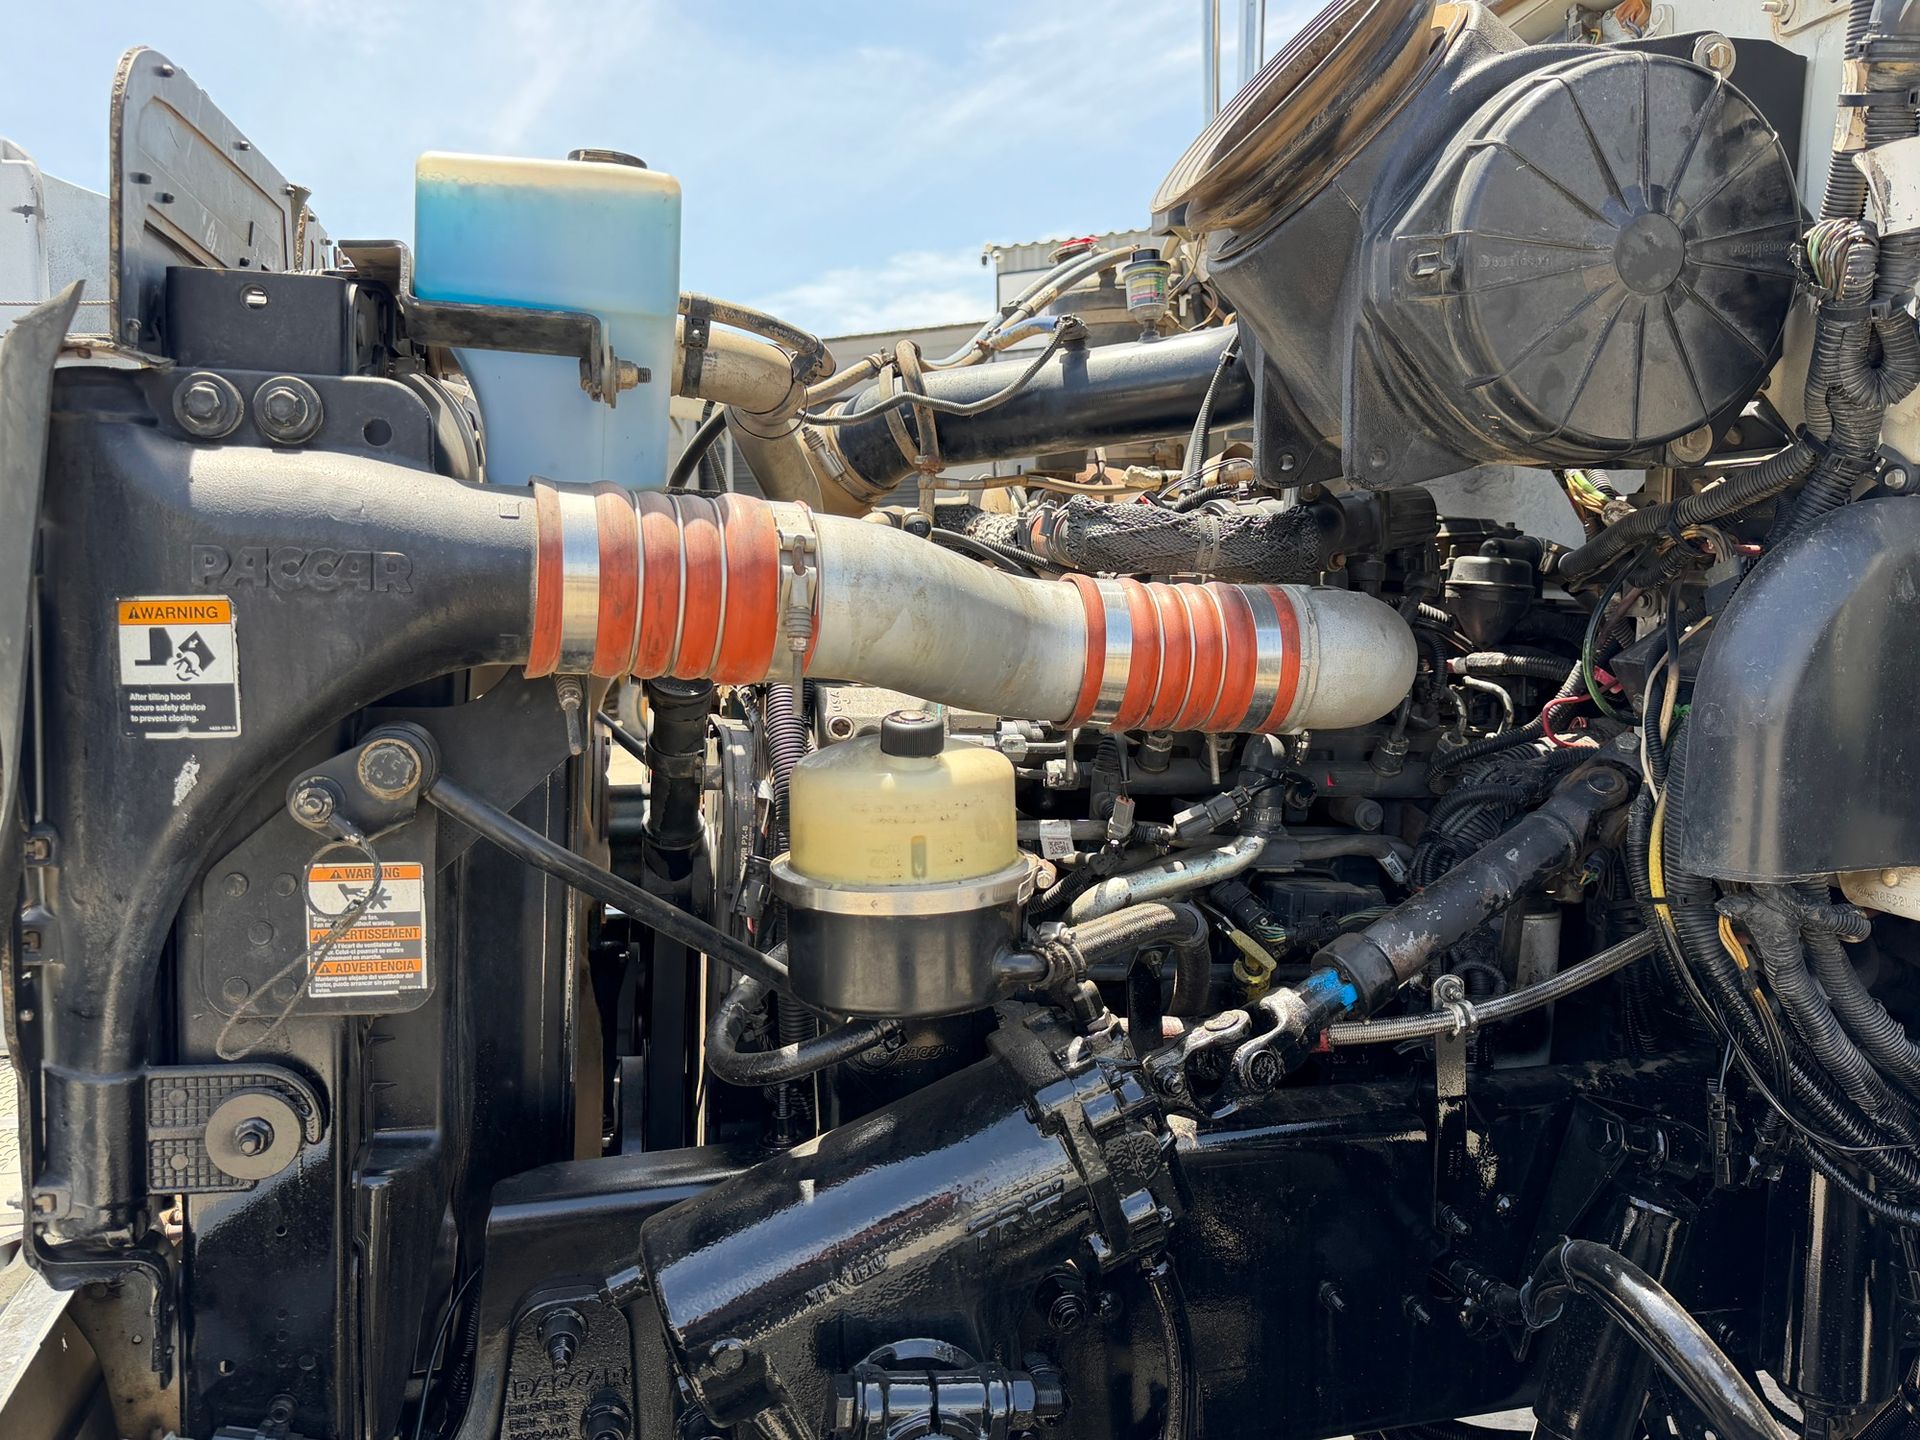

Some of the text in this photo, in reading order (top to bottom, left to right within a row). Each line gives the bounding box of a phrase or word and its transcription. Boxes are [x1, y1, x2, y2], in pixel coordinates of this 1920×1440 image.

[191, 544, 414, 594] PACCAR
[140, 606, 218, 619] WARNING
[129, 692, 191, 702] After tilting hood
[155, 704, 178, 713] safety
[180, 703, 206, 711] device
[139, 715, 167, 723] prevent
[168, 714, 199, 723] closing.
[345, 867, 400, 879] WARNG
[336, 960, 415, 973] ADVERTENCIA
[512, 1366, 630, 1400] PACCAR
